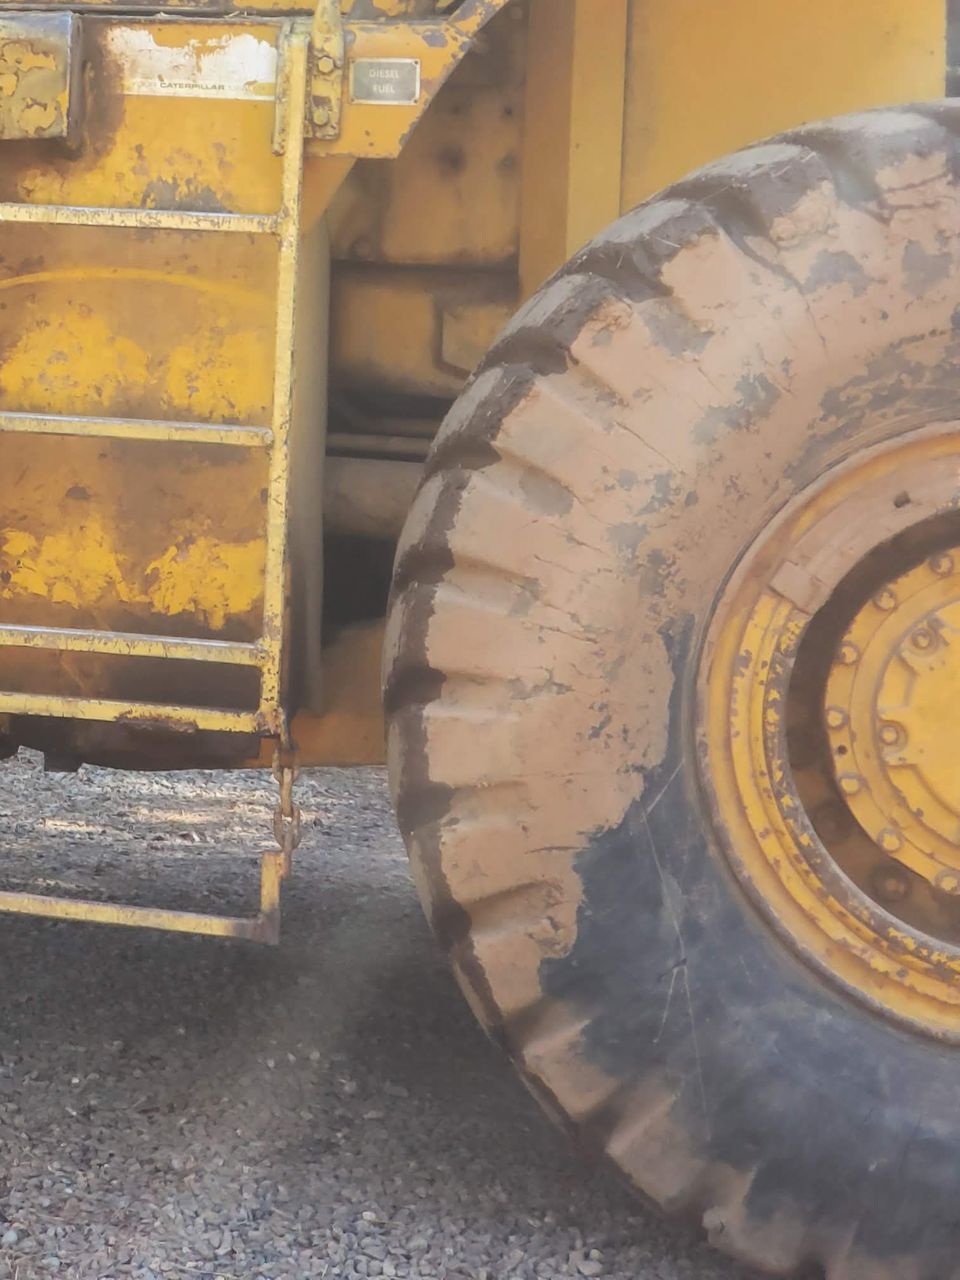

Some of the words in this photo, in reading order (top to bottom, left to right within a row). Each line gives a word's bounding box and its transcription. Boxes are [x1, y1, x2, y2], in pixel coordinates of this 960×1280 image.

[369, 69, 399, 79] DIESEL
[159, 81, 225, 91] CATERPILLAR
[372, 84, 395, 94] FUEL
